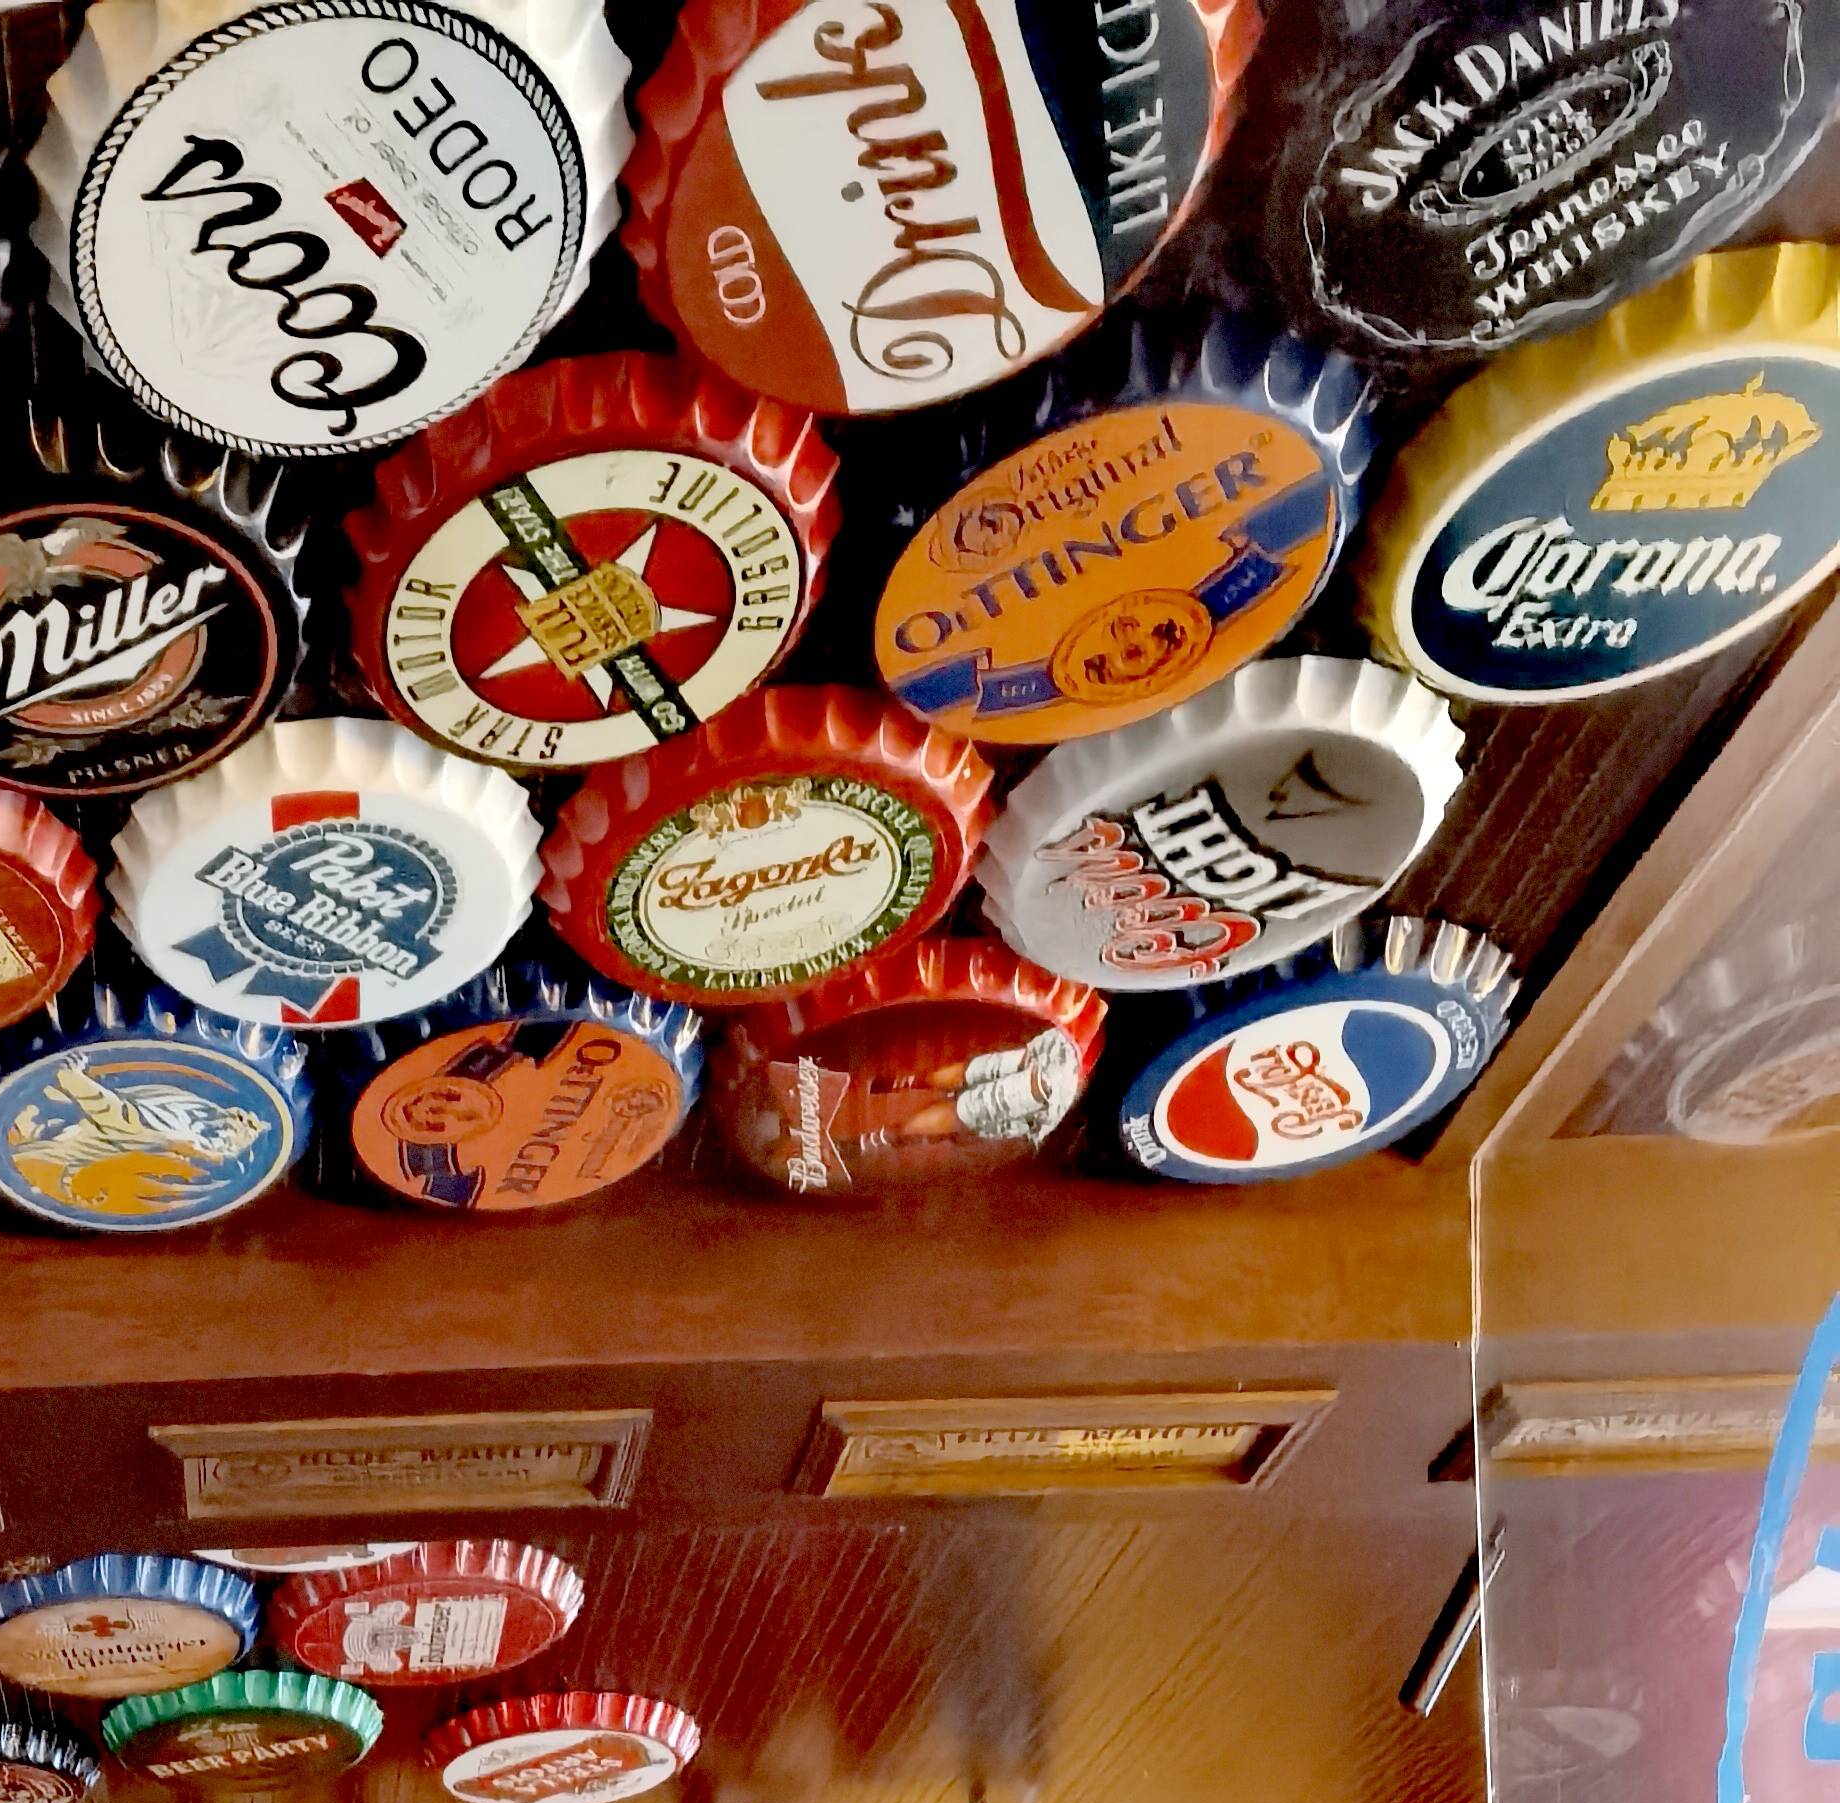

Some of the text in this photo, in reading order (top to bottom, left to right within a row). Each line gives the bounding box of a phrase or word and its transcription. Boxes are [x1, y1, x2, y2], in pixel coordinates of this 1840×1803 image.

[360, 36, 553, 253] RODEO
[754, 2, 1027, 383] Drink
[1102, 97, 1168, 236] LIKE
[1340, 86, 1473, 212] JACK
[139, 133, 428, 437] Coors
[1441, 515, 1782, 621] Corona
[1491, 600, 1639, 649] Extra
[70, 700, 131, 726] SINCE
[448, 702, 564, 760] STAR
[289, 831, 432, 919] Pabst
[657, 833, 881, 913] Zagorka
[1131, 782, 1370, 922] LIGHT
[203, 848, 420, 977] Blue Ribbon
[146, 1734, 331, 1779] BEER PARTY
